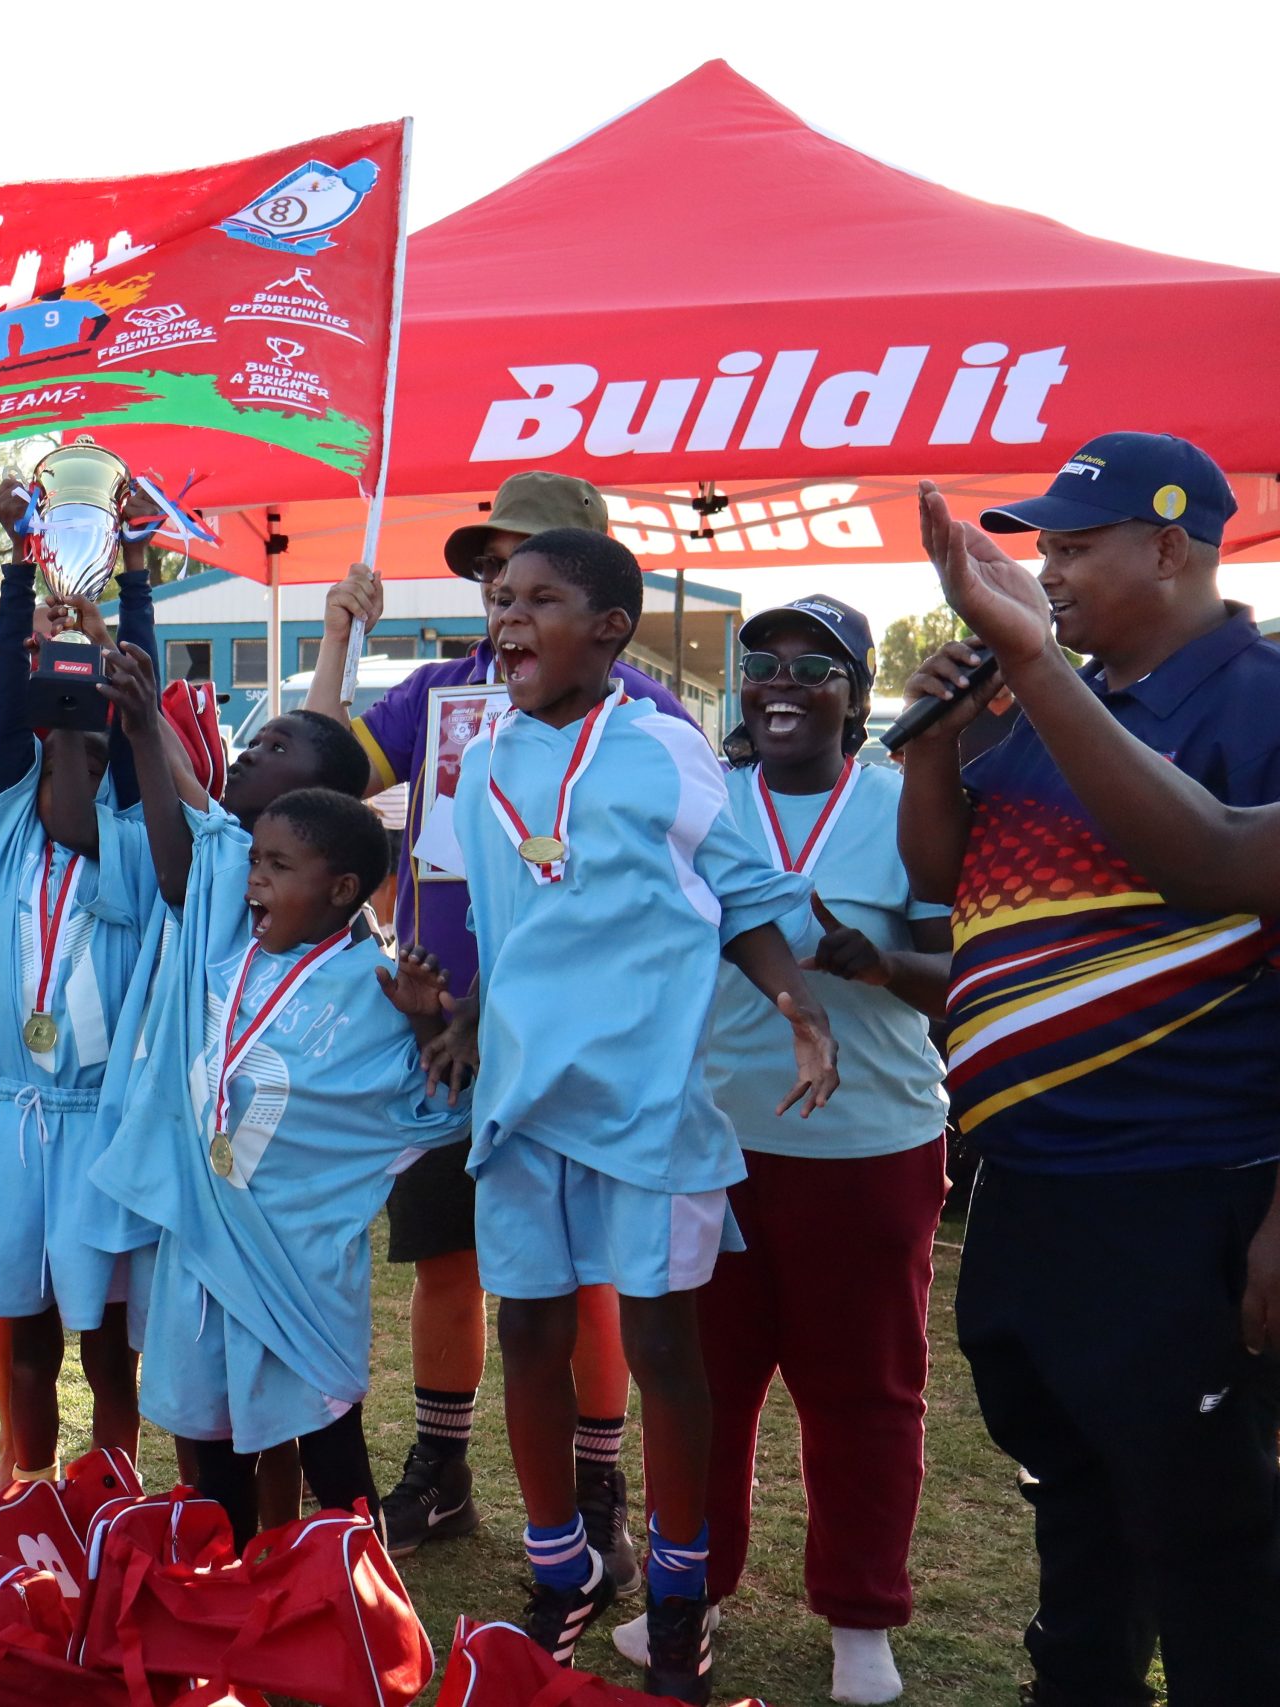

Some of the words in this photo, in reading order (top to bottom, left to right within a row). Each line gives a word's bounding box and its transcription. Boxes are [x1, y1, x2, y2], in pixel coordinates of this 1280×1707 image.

[244, 233, 298, 254] PROGRESS
[253, 293, 329, 312] BUILDING
[44, 310, 60, 328] 9
[229, 304, 350, 328] OPPORTUNITIES
[97, 326, 217, 360] FRIENDSHIPS.
[115, 319, 200, 344] BUILDING
[244, 361, 320, 385] BUILDING
[230, 372, 244, 384] A
[249, 373, 330, 400] BRIGHTER
[247, 385, 311, 403] FUTURE.
[468, 345, 929, 463] Build
[928, 341, 1069, 447] it
[17, 1533, 81, 1598] B
